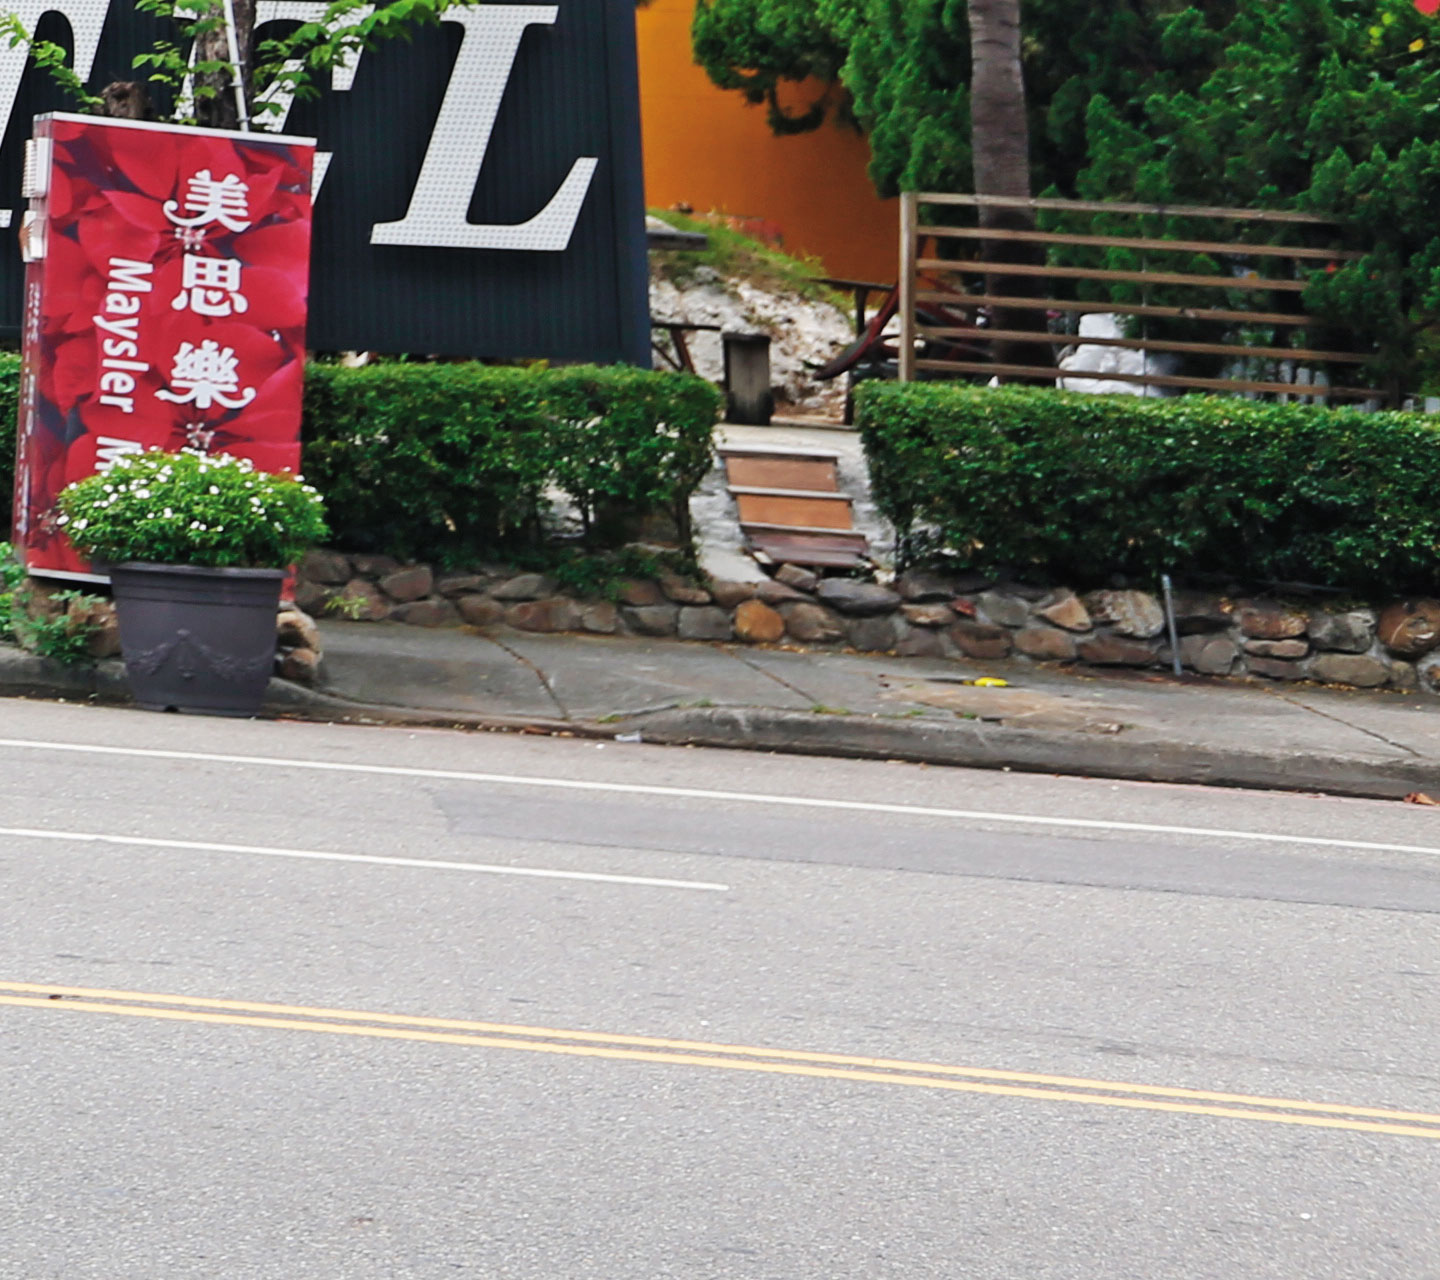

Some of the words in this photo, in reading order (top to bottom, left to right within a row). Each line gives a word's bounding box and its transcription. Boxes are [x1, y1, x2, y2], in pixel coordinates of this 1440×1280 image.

[93, 256, 153, 414] Maysler
[154, 169, 256, 410] 美思樂
